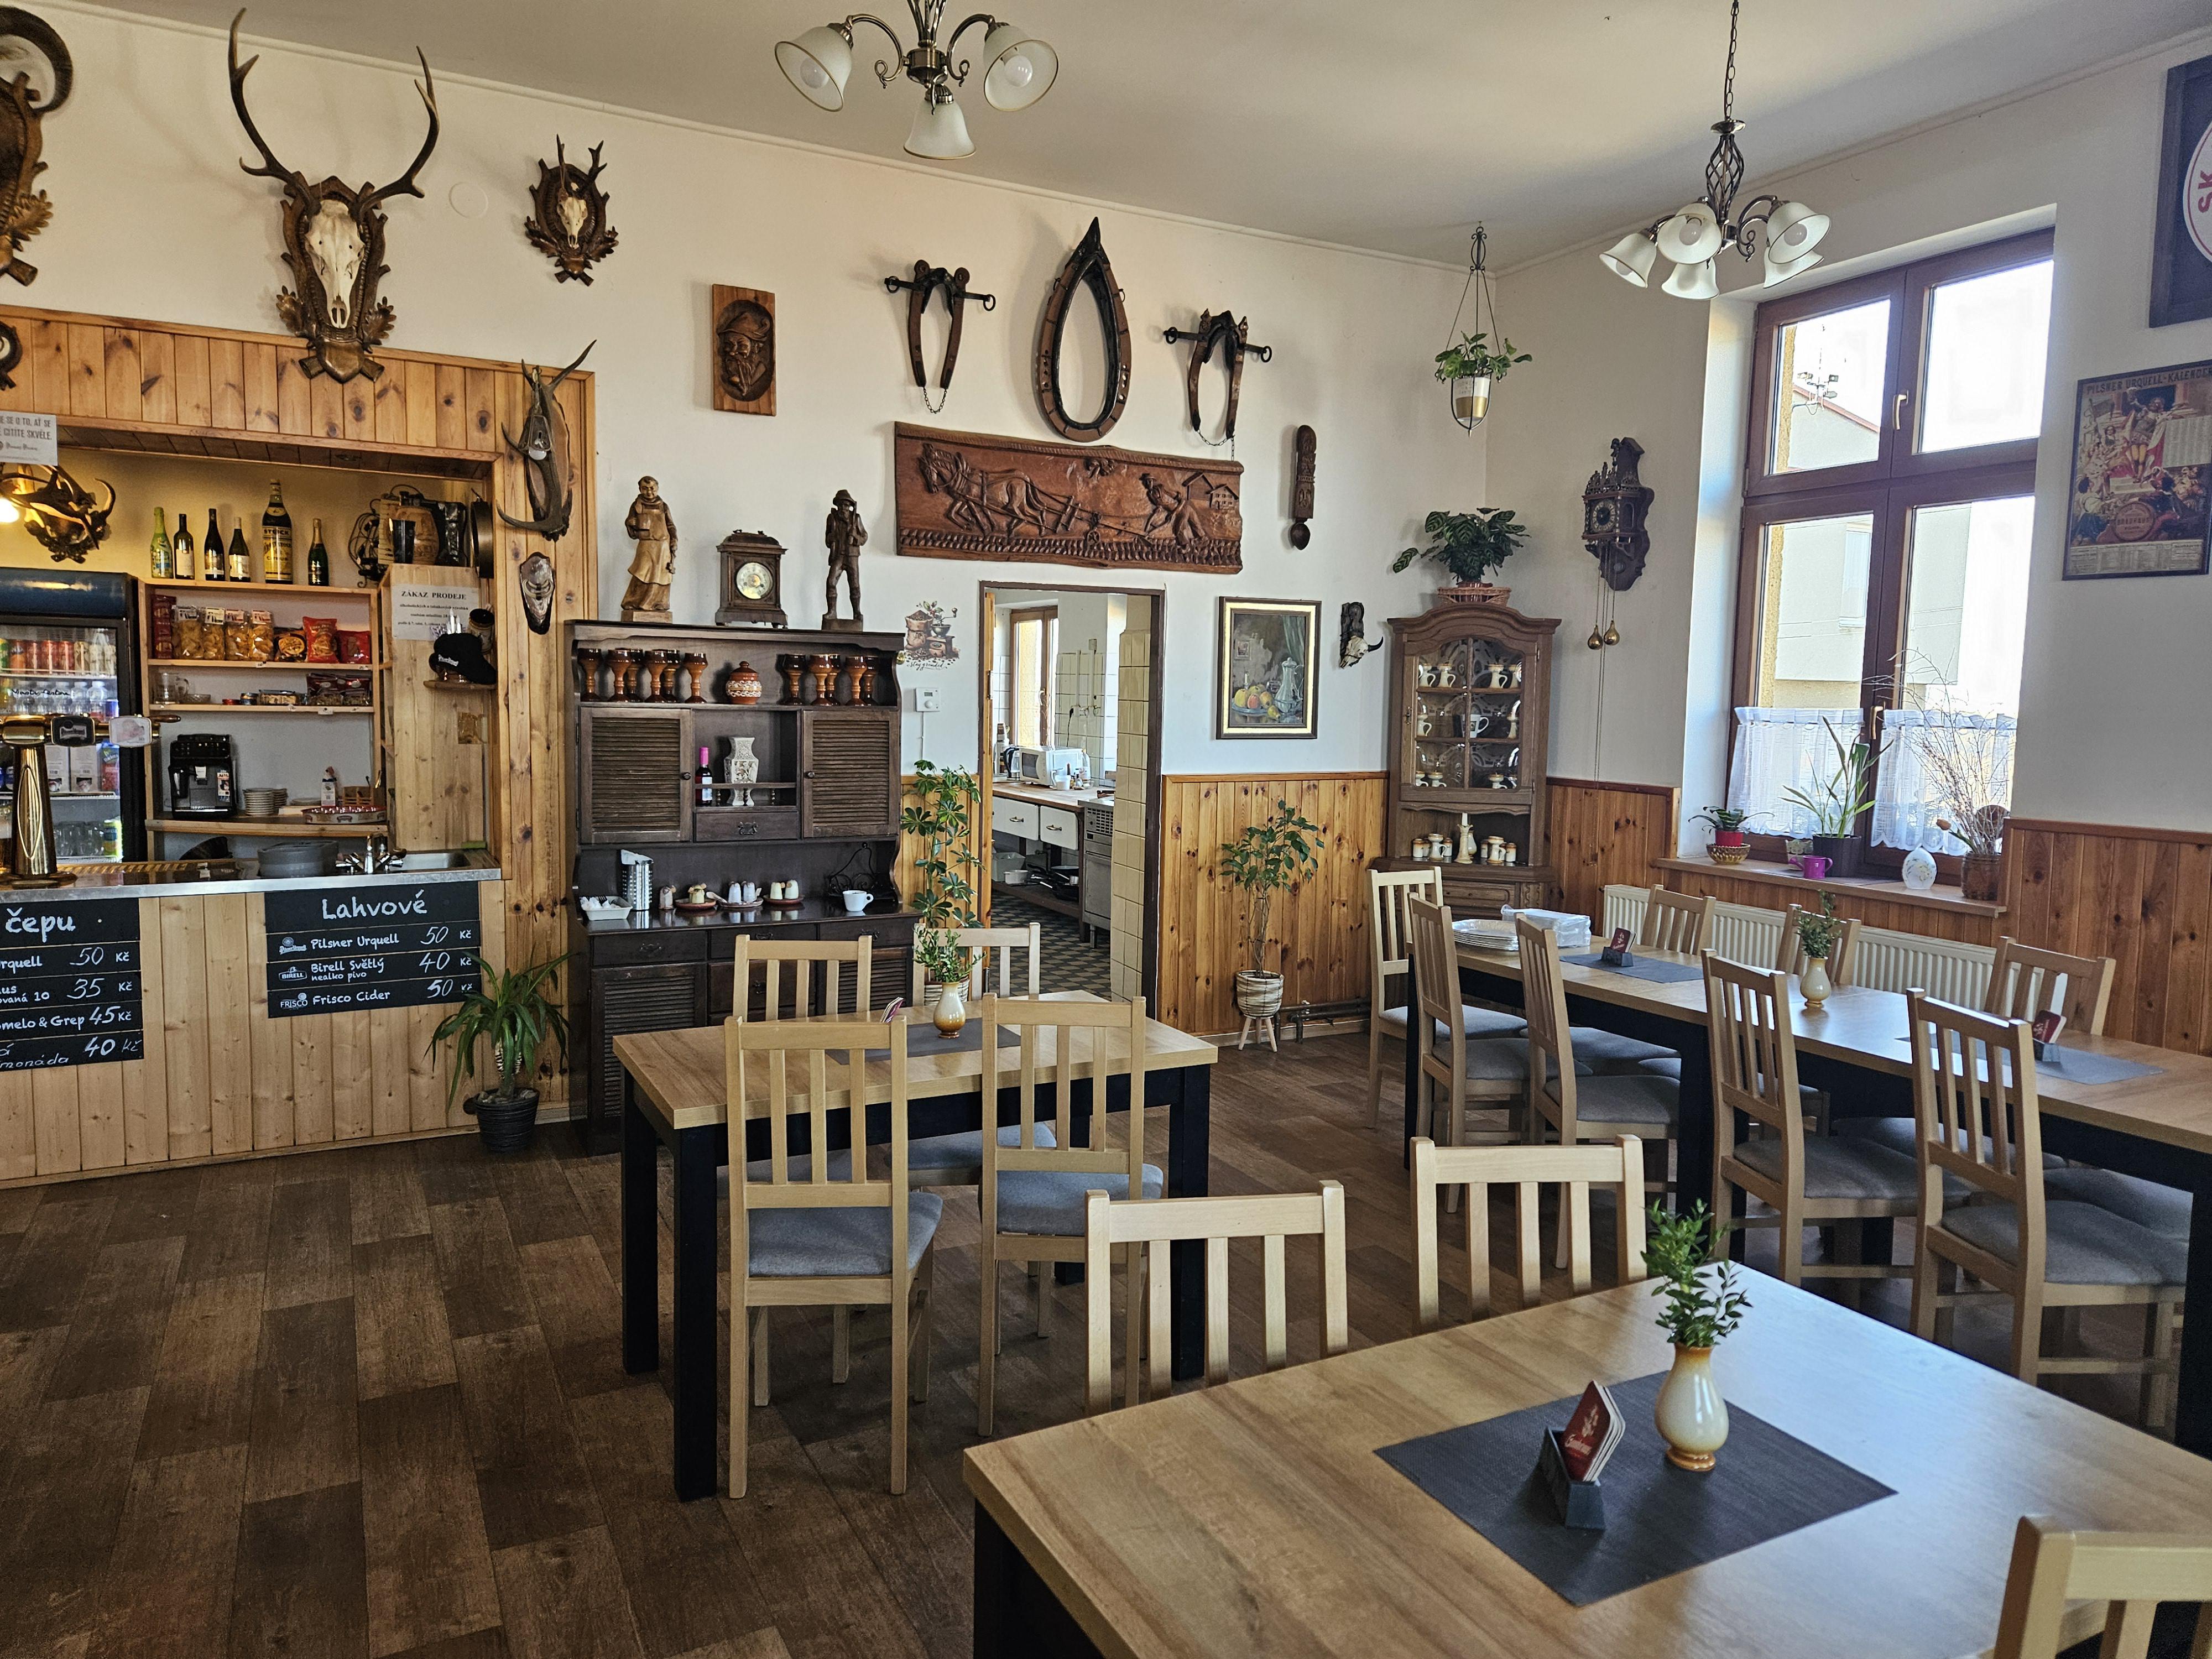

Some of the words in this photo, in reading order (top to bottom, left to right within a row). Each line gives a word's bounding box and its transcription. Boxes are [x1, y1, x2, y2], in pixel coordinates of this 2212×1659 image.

[2086, 382, 2122, 394] PILSNER
[401, 589, 429, 598] ZÁKAZ
[322, 889, 427, 919] Lahvové
[5, 907, 76, 943] čepu
[311, 938, 353, 950] Pilsner
[357, 933, 399, 950] Urquell
[420, 926, 448, 945] 50
[460, 930, 471, 939] Kč
[0, 956, 43, 974] rquell
[70, 947, 104, 966] 50
[116, 951, 129, 962] Kč
[311, 961, 345, 973] Birell
[349, 958, 384, 973] Světlý
[419, 952, 450, 973] 40
[460, 957, 472, 966] Kč
[312, 972, 343, 981] nealko
[348, 971, 367, 982] pivo
[34, 992, 50, 1001] 10
[67, 978, 105, 999] 35
[118, 981, 133, 992] Kč
[313, 995, 351, 1005] Frisco
[356, 989, 390, 1001] Cider
[427, 979, 453, 998] 50
[0, 1018, 36, 1030] melo
[39, 1016, 47, 1027] &
[50, 1015, 84, 1030] Grep
[89, 1006, 121, 1025] 45
[118, 1011, 132, 1021] Kč
[85, 1036, 116, 1057] 40
[121, 1039, 142, 1052] Kč
